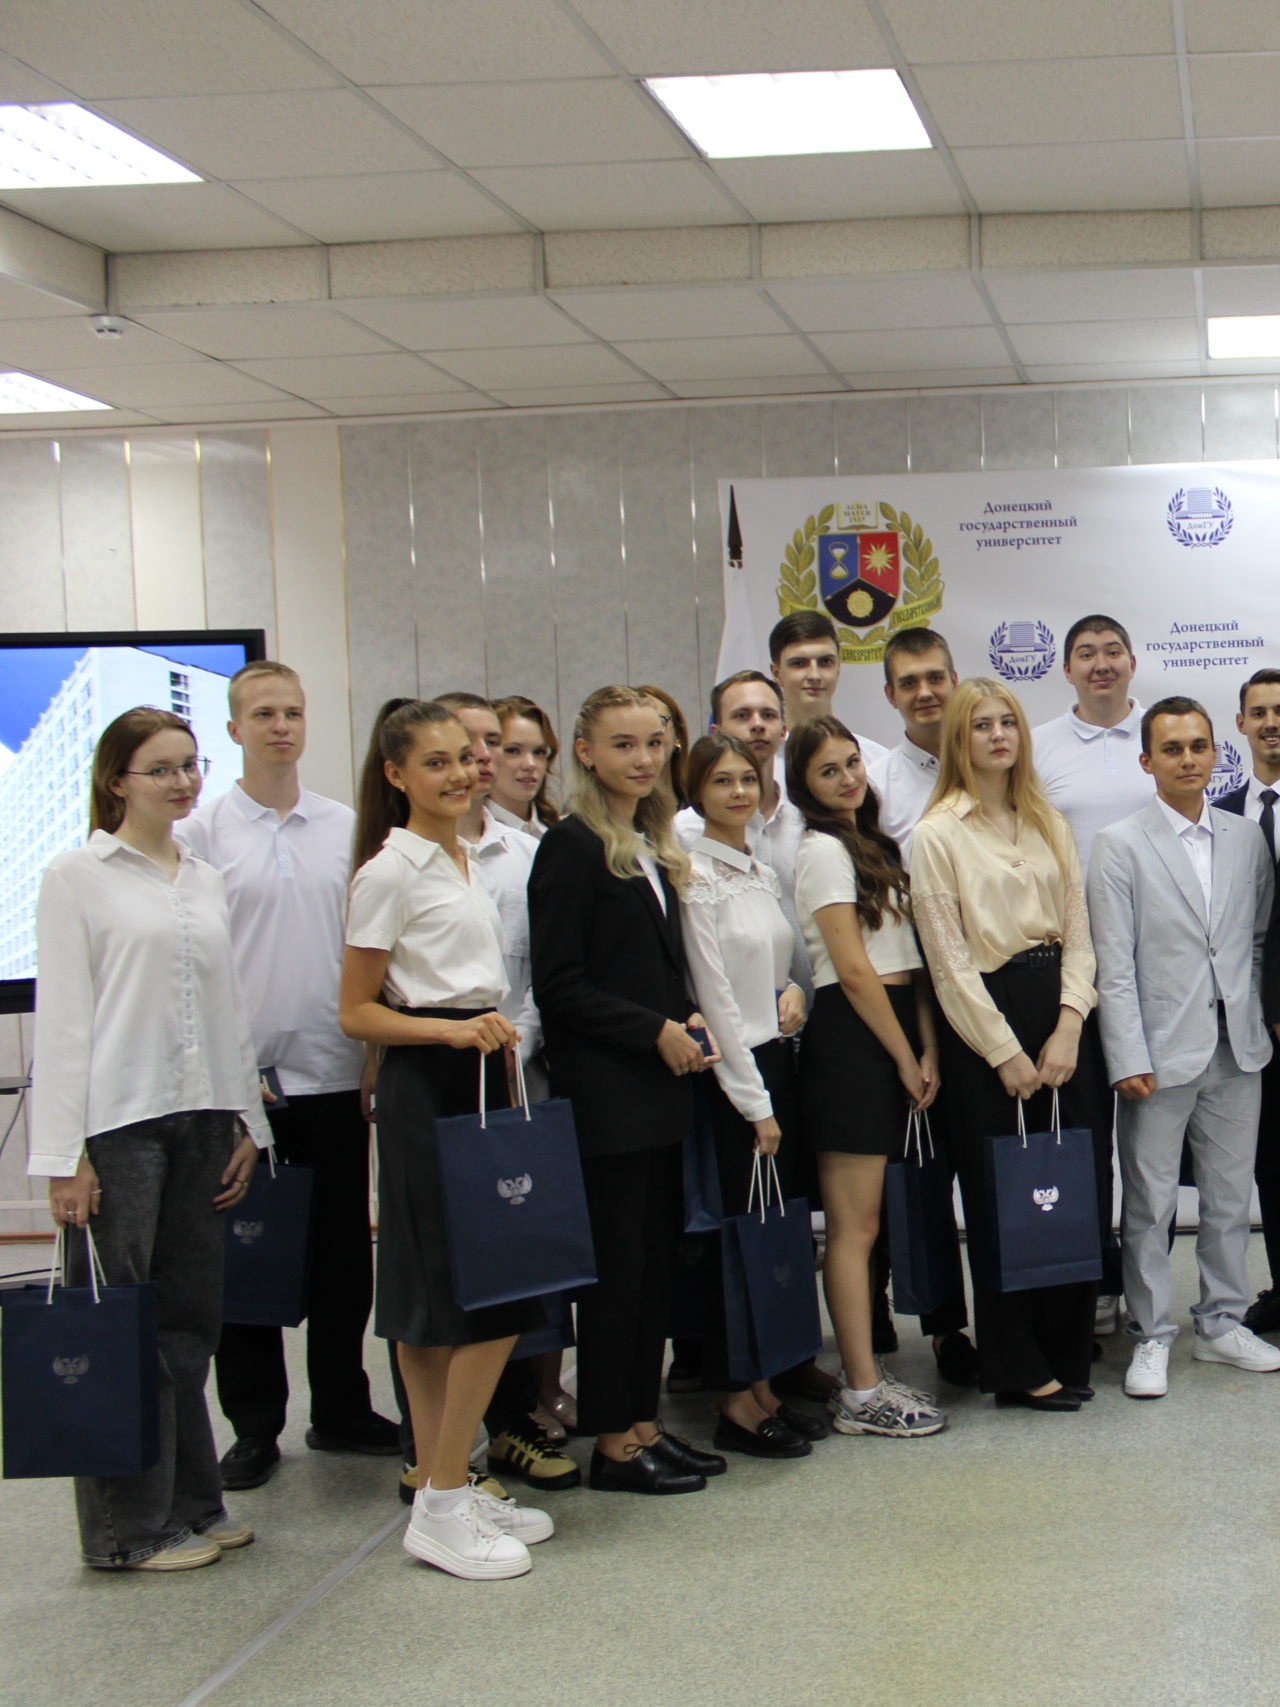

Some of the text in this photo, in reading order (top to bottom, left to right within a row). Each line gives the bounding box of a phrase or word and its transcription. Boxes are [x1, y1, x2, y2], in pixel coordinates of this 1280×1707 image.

[983, 500, 1053, 515] Донецкий
[959, 516, 1078, 533] государственный
[975, 535, 1063, 550] университет
[1170, 620, 1239, 635] Донецкий
[1145, 637, 1265, 653] государственный
[1162, 656, 1249, 671] университет
